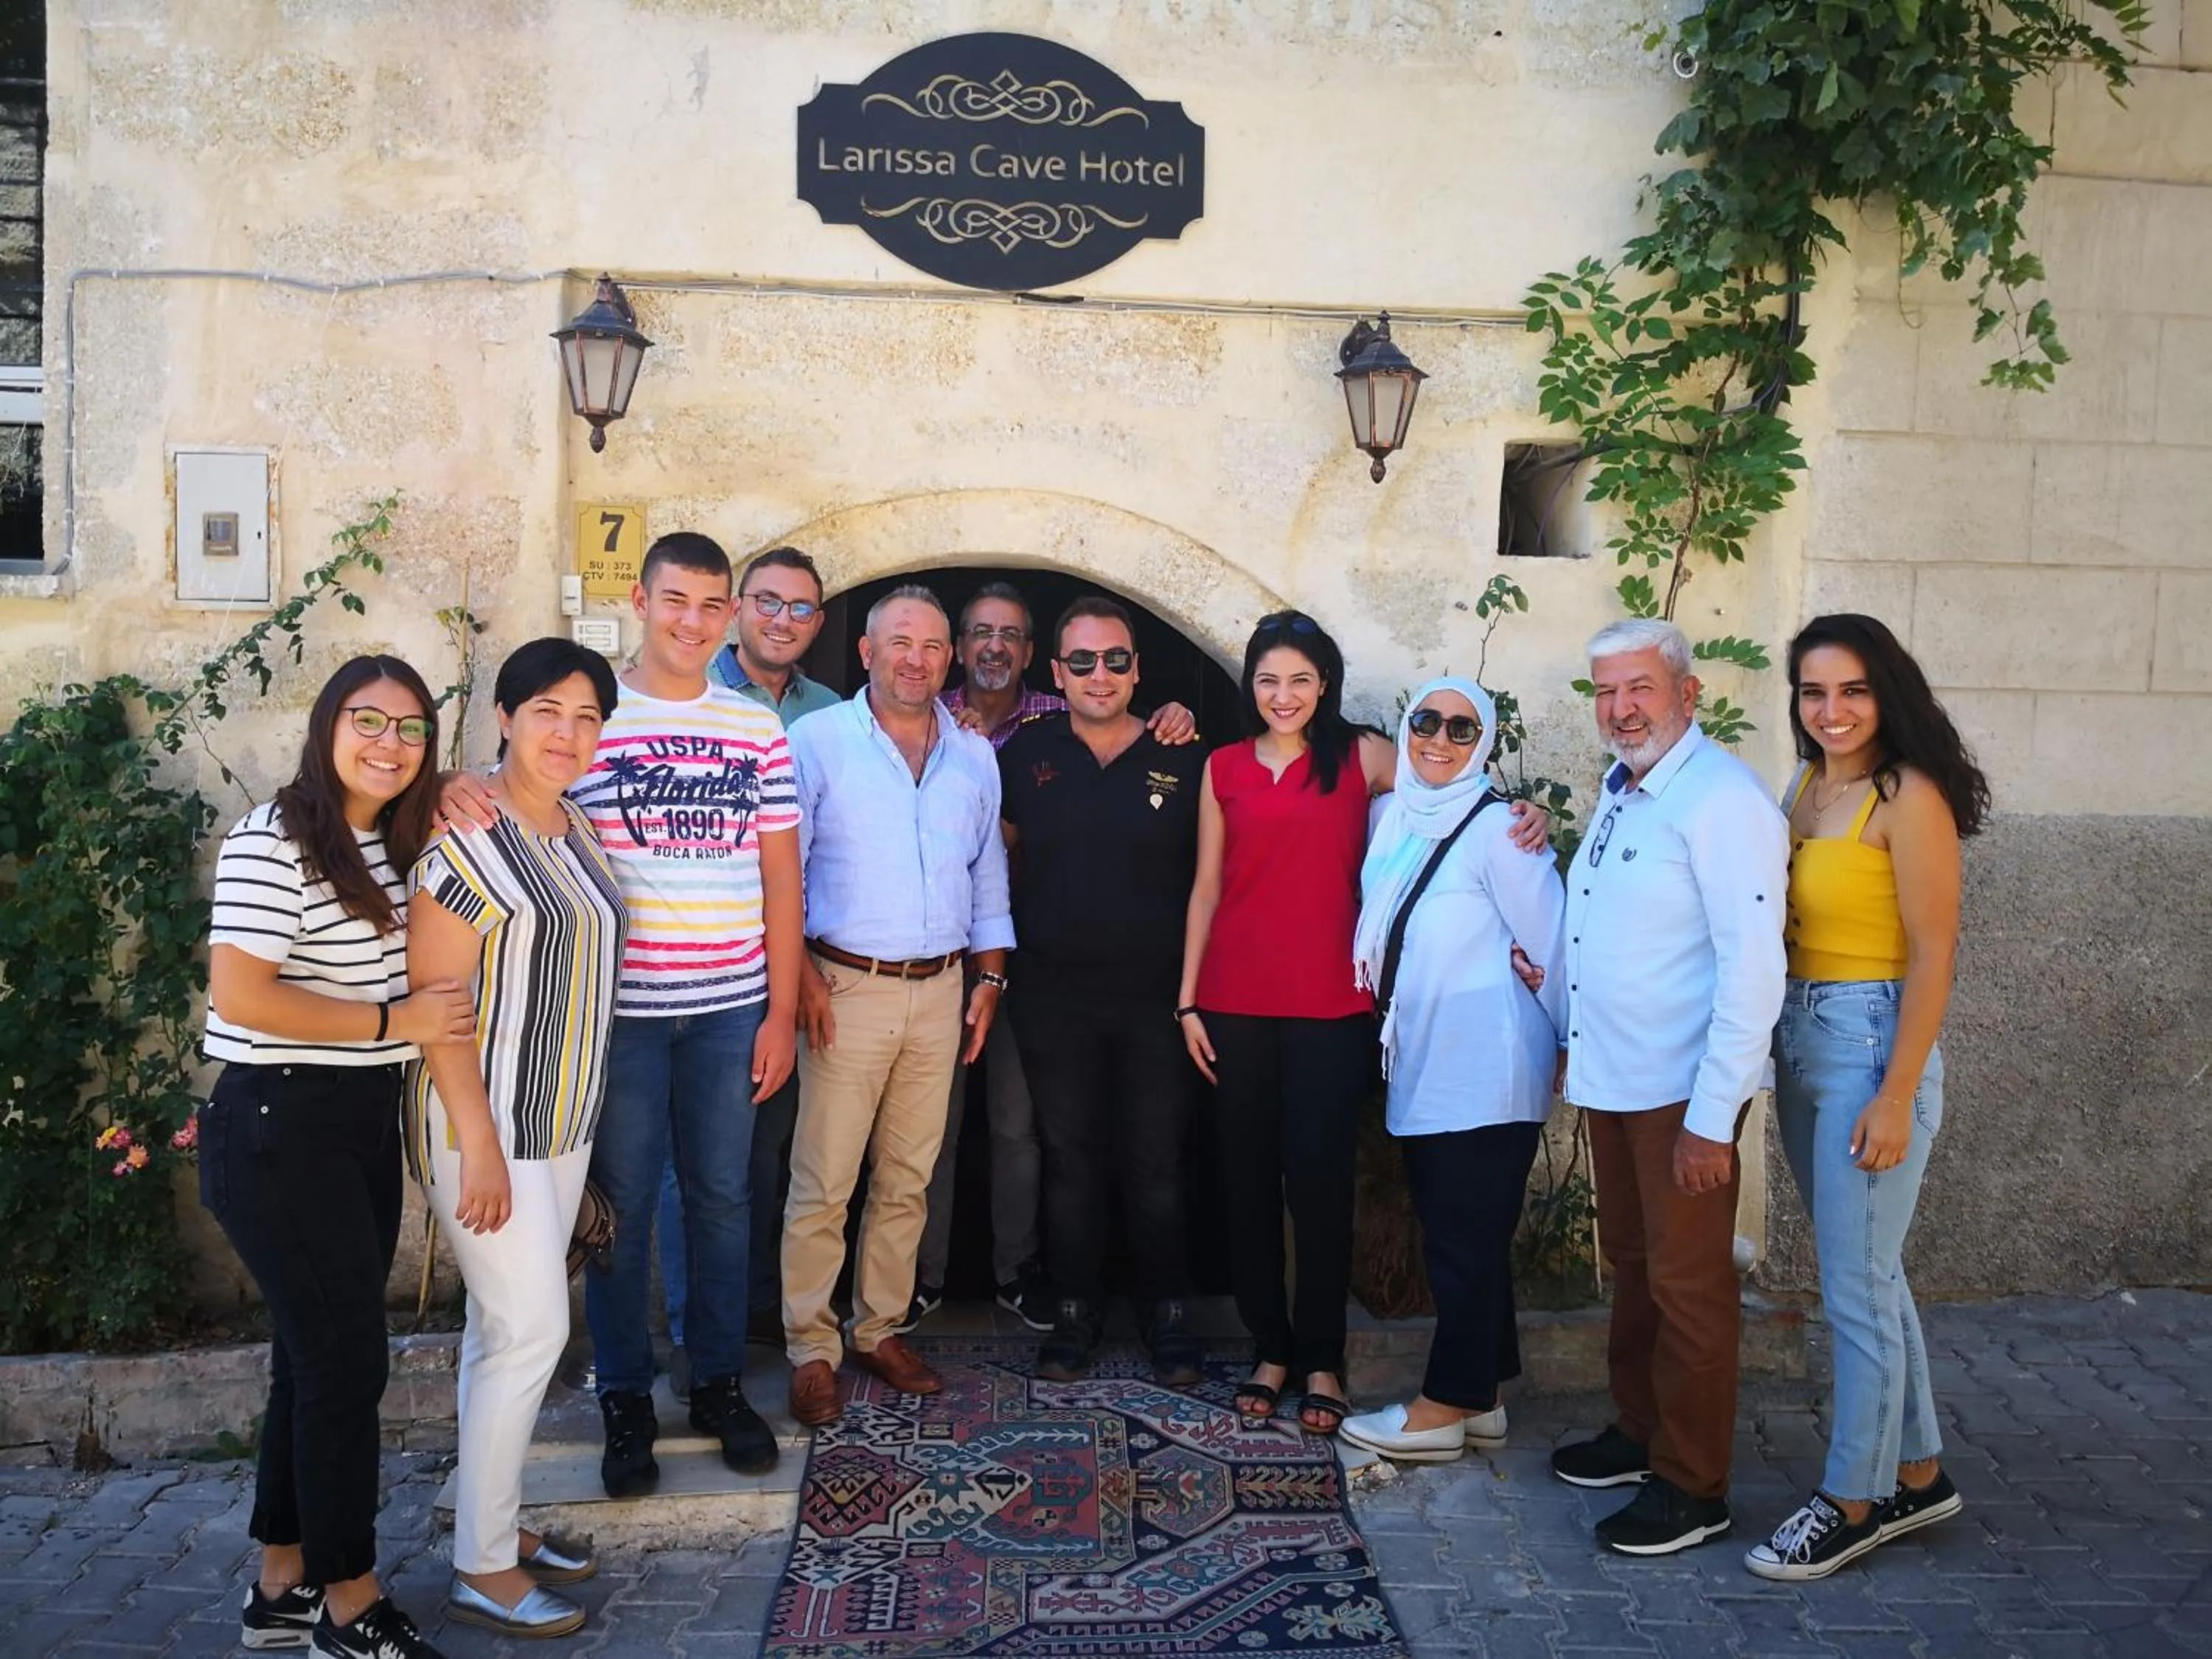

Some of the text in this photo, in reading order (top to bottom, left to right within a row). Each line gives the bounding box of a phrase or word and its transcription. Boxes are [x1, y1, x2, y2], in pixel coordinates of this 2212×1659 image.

[818, 138, 1184, 187] Larissa Cave Hotel
[599, 511, 625, 552] 7
[647, 735, 724, 762] USPA
[662, 807, 725, 841] 1890
[652, 844, 691, 860] BOCA
